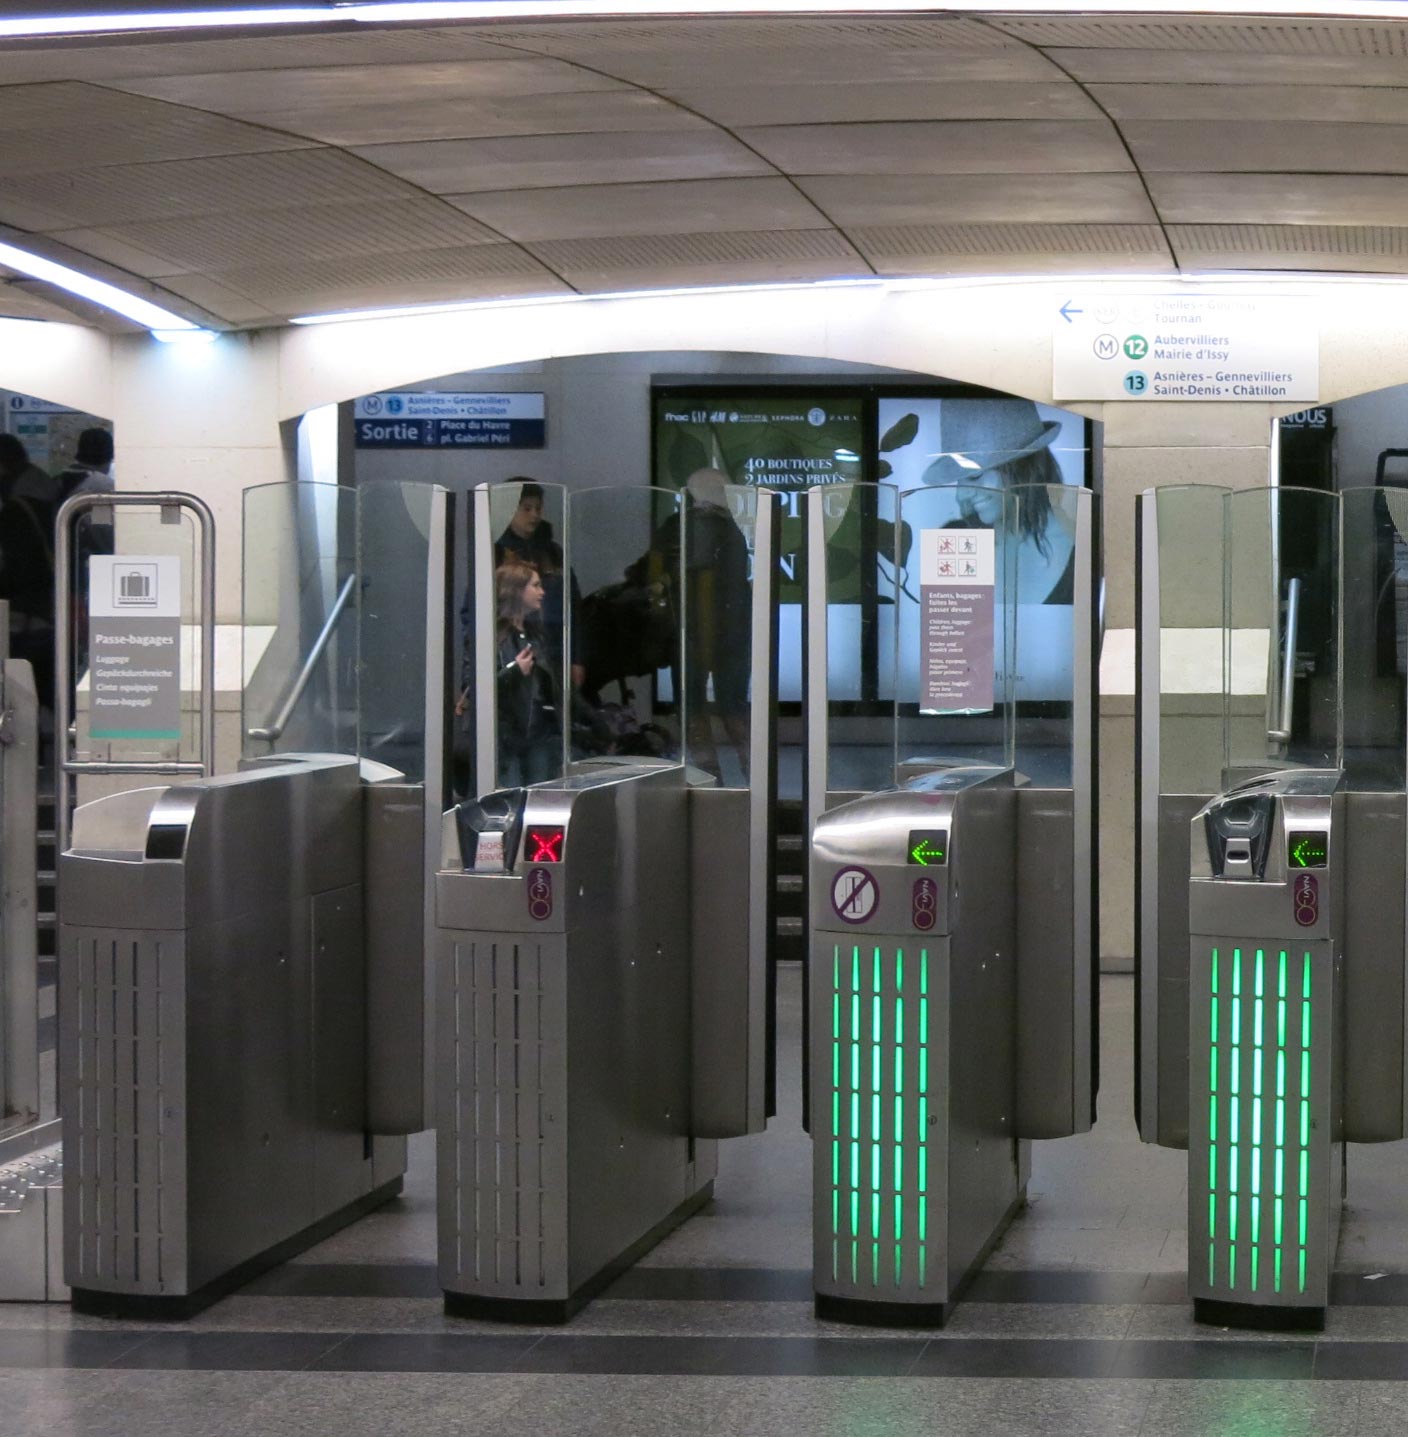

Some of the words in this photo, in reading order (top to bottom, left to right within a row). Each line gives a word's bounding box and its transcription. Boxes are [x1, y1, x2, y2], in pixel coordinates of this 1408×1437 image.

[1154, 314, 1202, 324] Tournan
[1154, 335, 1230, 346] Aubervilliers
[1100, 341, 1114, 354] M
[1126, 340, 1146, 354] 12
[1154, 349, 1192, 360] Mairie
[1196, 349, 1230, 362] d’Issy
[1154, 371, 1204, 382] Asnières
[1215, 371, 1293, 382] Gennevilliers
[1127, 376, 1145, 390] 13
[1154, 385, 1222, 396] Saint-Denis
[1232, 384, 1286, 396] Châtillon
[388, 399, 401, 412] 13
[408, 396, 445, 405] Asnières
[453, 396, 511, 405] Gennevilliers
[408, 406, 458, 415] Saint-Denis
[665, 412, 689, 422] fnac
[426, 421, 433, 429] 2
[440, 420, 467, 430] Place
[468, 420, 481, 430] du
[483, 420, 511, 430] Havre
[362, 423, 419, 441] Sortie
[454, 434, 490, 443] Gabriel
[492, 434, 511, 443] Péri
[744, 458, 765, 473] 40
[768, 458, 833, 471] BOUTIQUES
[745, 474, 754, 487] 2
[756, 474, 804, 486] JARDINS
[928, 592, 955, 600] Enfants,
[96, 634, 174, 647] Passe-bagages
[96, 655, 130, 665] Luggage
